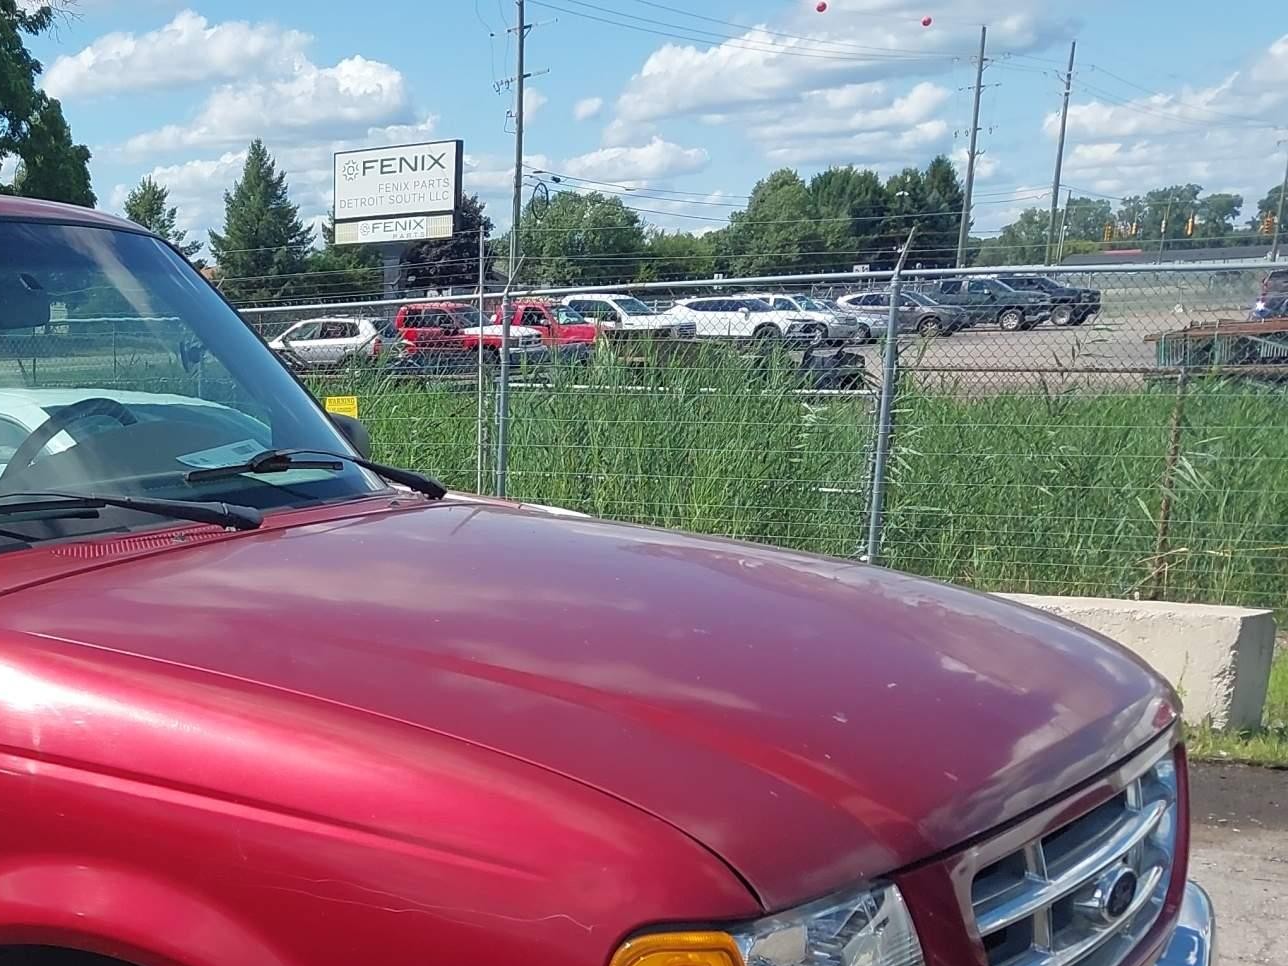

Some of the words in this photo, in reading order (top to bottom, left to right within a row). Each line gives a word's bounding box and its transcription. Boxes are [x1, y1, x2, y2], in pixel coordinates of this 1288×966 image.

[362, 152, 446, 176] FENIX
[378, 182, 410, 193] FENIX
[413, 178, 450, 190] PARTS
[339, 196, 384, 209] DETROIT
[389, 193, 425, 205] SOUTH
[430, 191, 449, 202] LLC
[372, 218, 425, 233] FENIX
